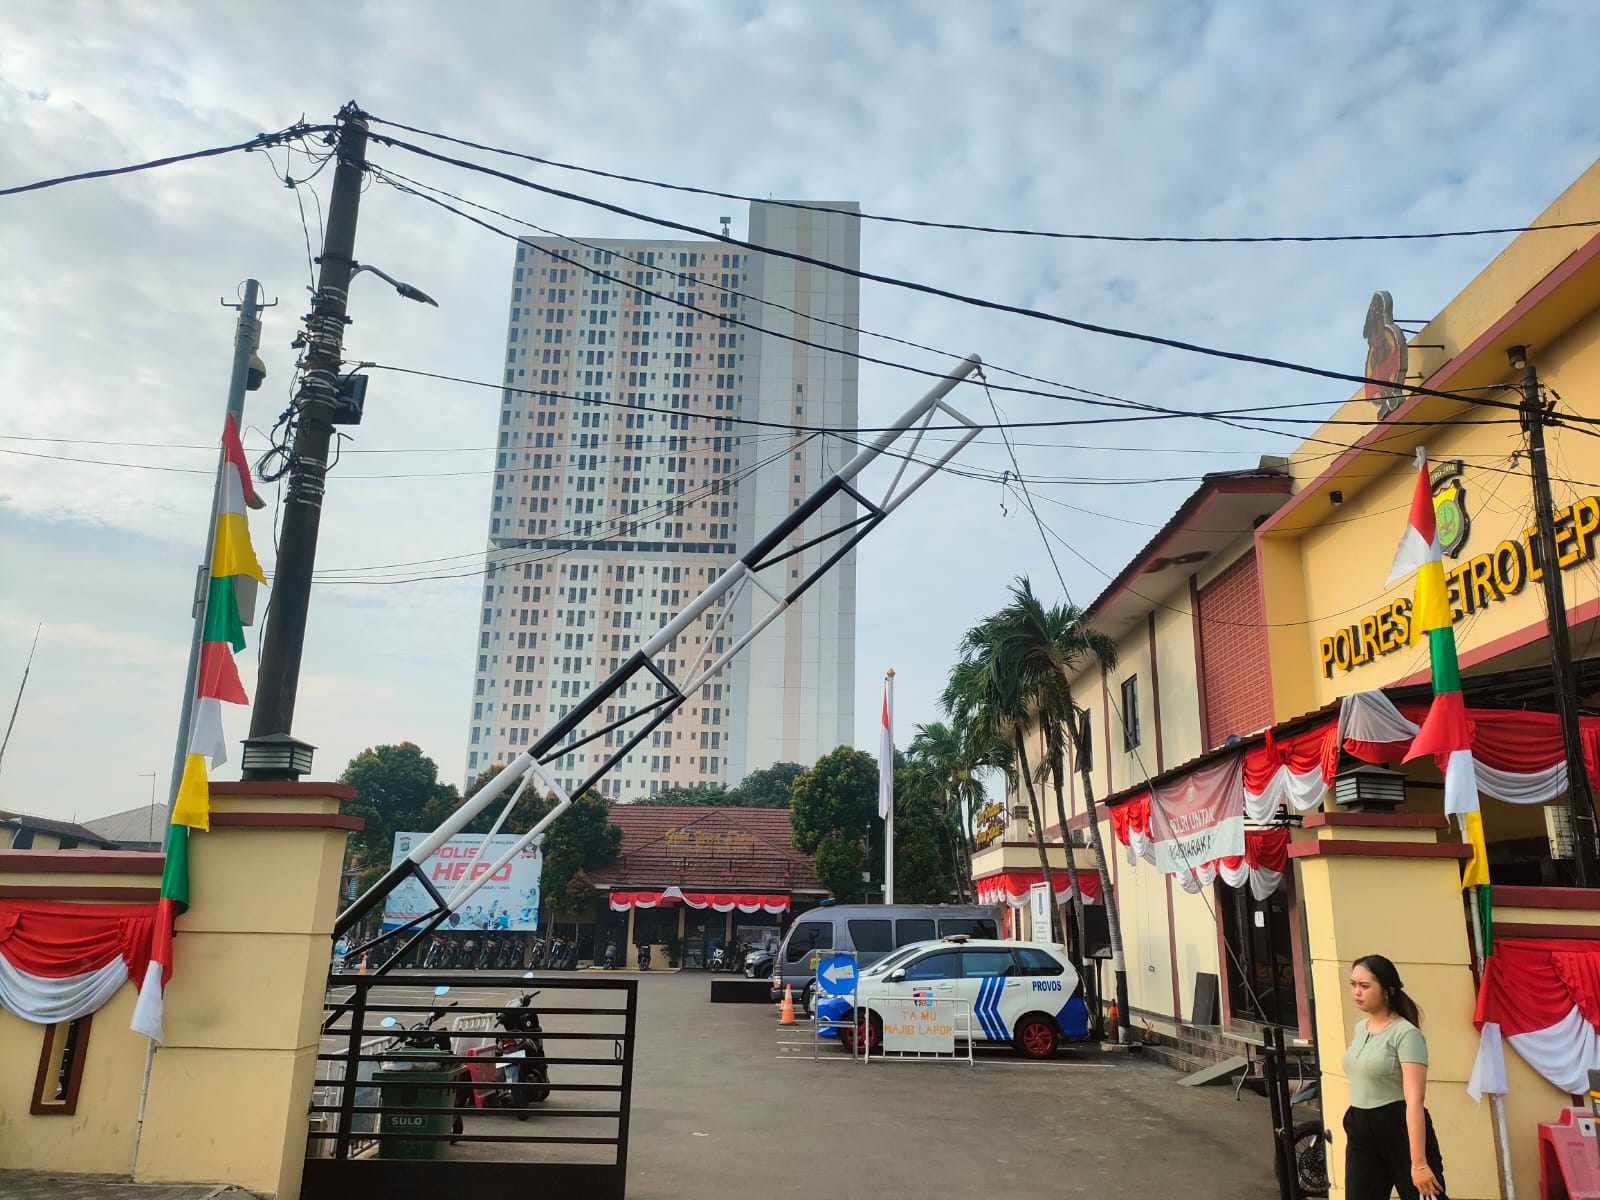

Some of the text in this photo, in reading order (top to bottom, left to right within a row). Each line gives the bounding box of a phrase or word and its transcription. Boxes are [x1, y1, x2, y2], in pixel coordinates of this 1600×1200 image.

[1320, 597, 1413, 678] POLRES
[1032, 980, 1062, 992] PROVOS
[884, 1024, 915, 1035] WAJIB
[391, 1116, 423, 1126] SULO
